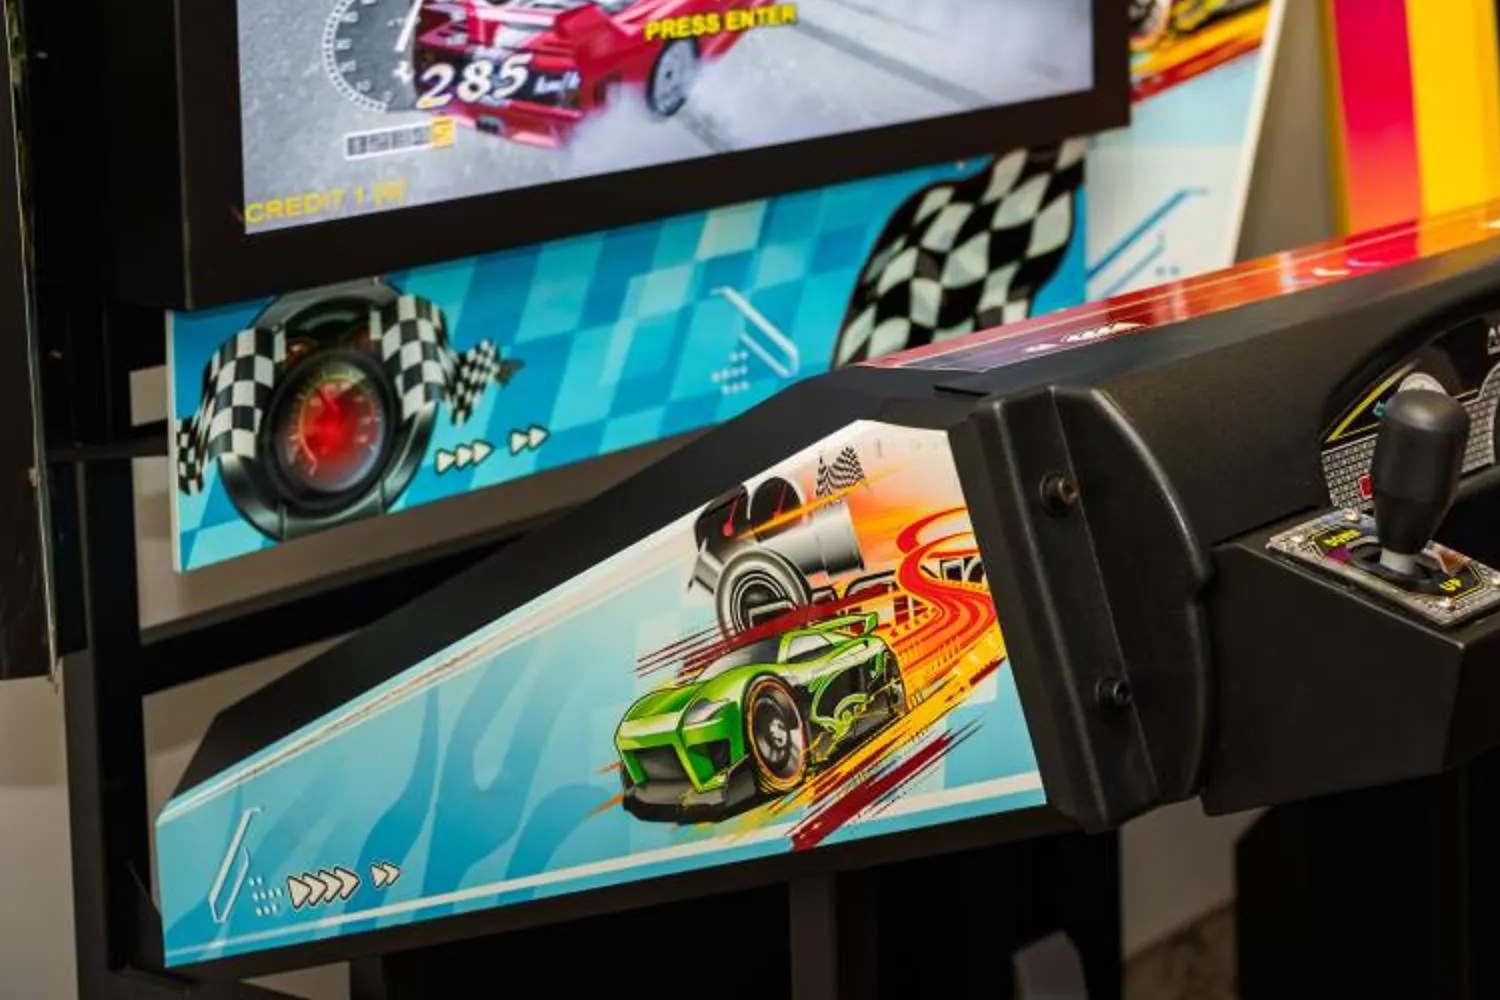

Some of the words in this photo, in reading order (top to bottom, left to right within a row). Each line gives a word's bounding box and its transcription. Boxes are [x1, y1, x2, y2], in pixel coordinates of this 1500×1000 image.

[644, 11, 721, 41] PRESS
[725, 3, 798, 32] ENTER
[416, 53, 533, 109] 285
[244, 186, 345, 224] CREDIT
